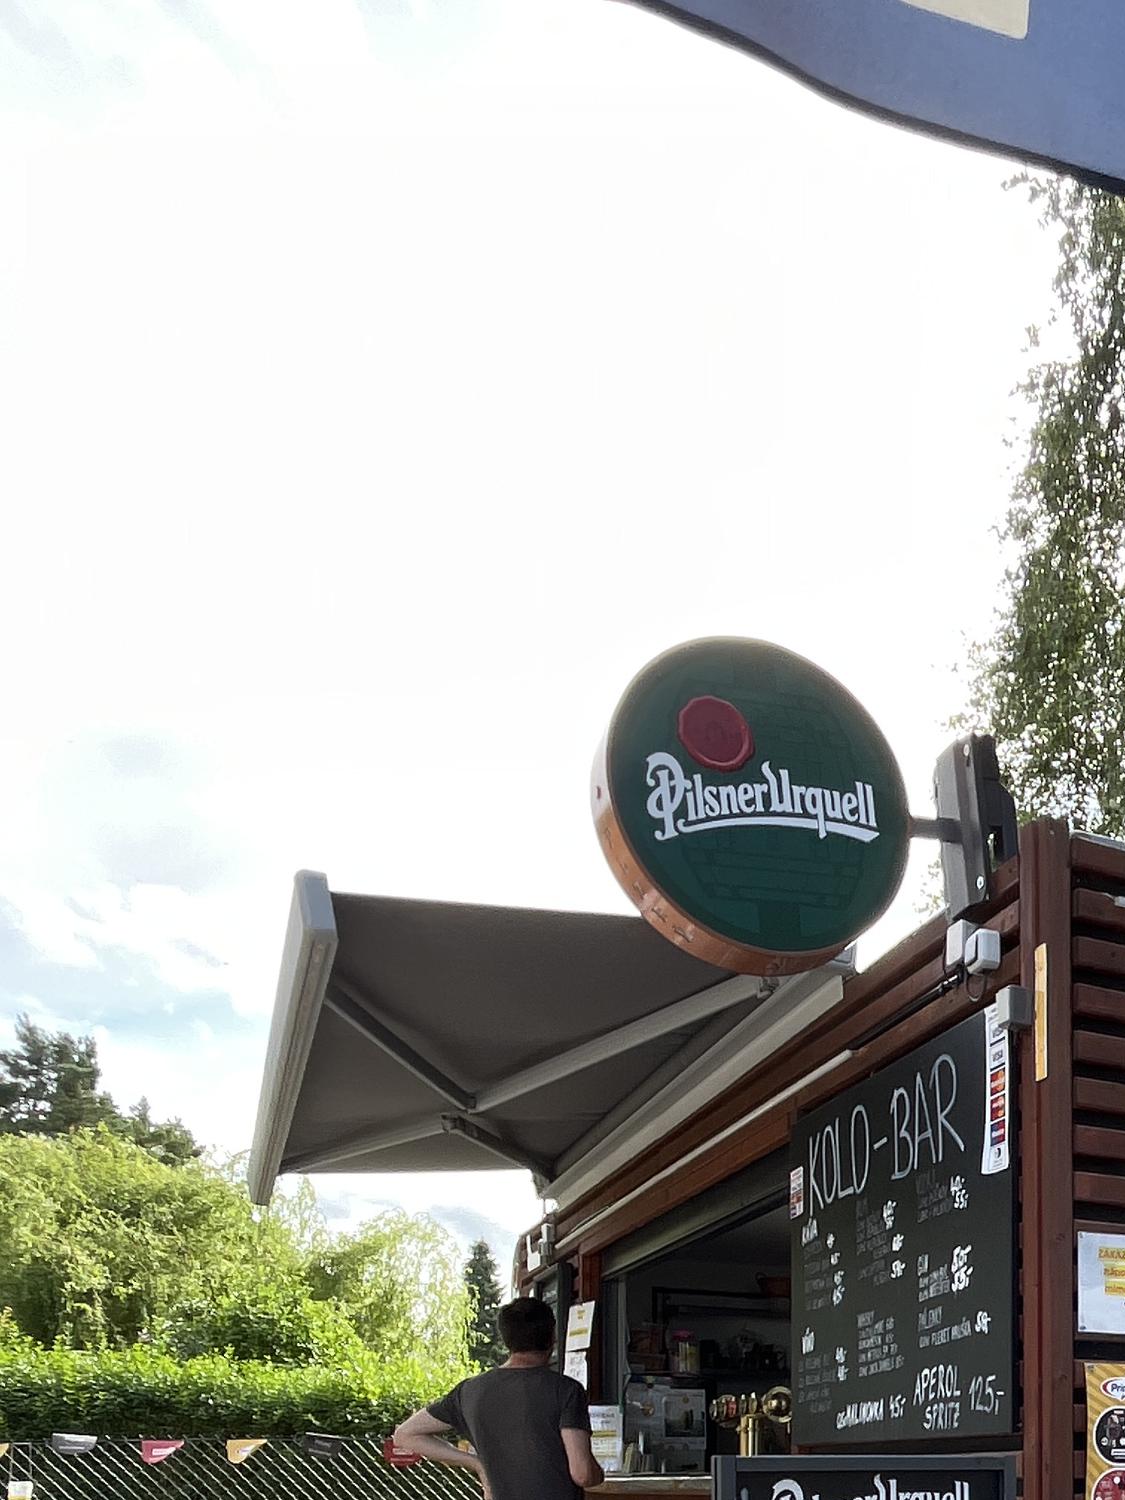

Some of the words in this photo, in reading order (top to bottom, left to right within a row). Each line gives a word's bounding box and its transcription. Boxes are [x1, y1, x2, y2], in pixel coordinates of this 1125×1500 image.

[645, 752, 766, 841] Pilsner
[761, 761, 877, 838] Urquell
[913, 1364, 961, 1406] APEROL
